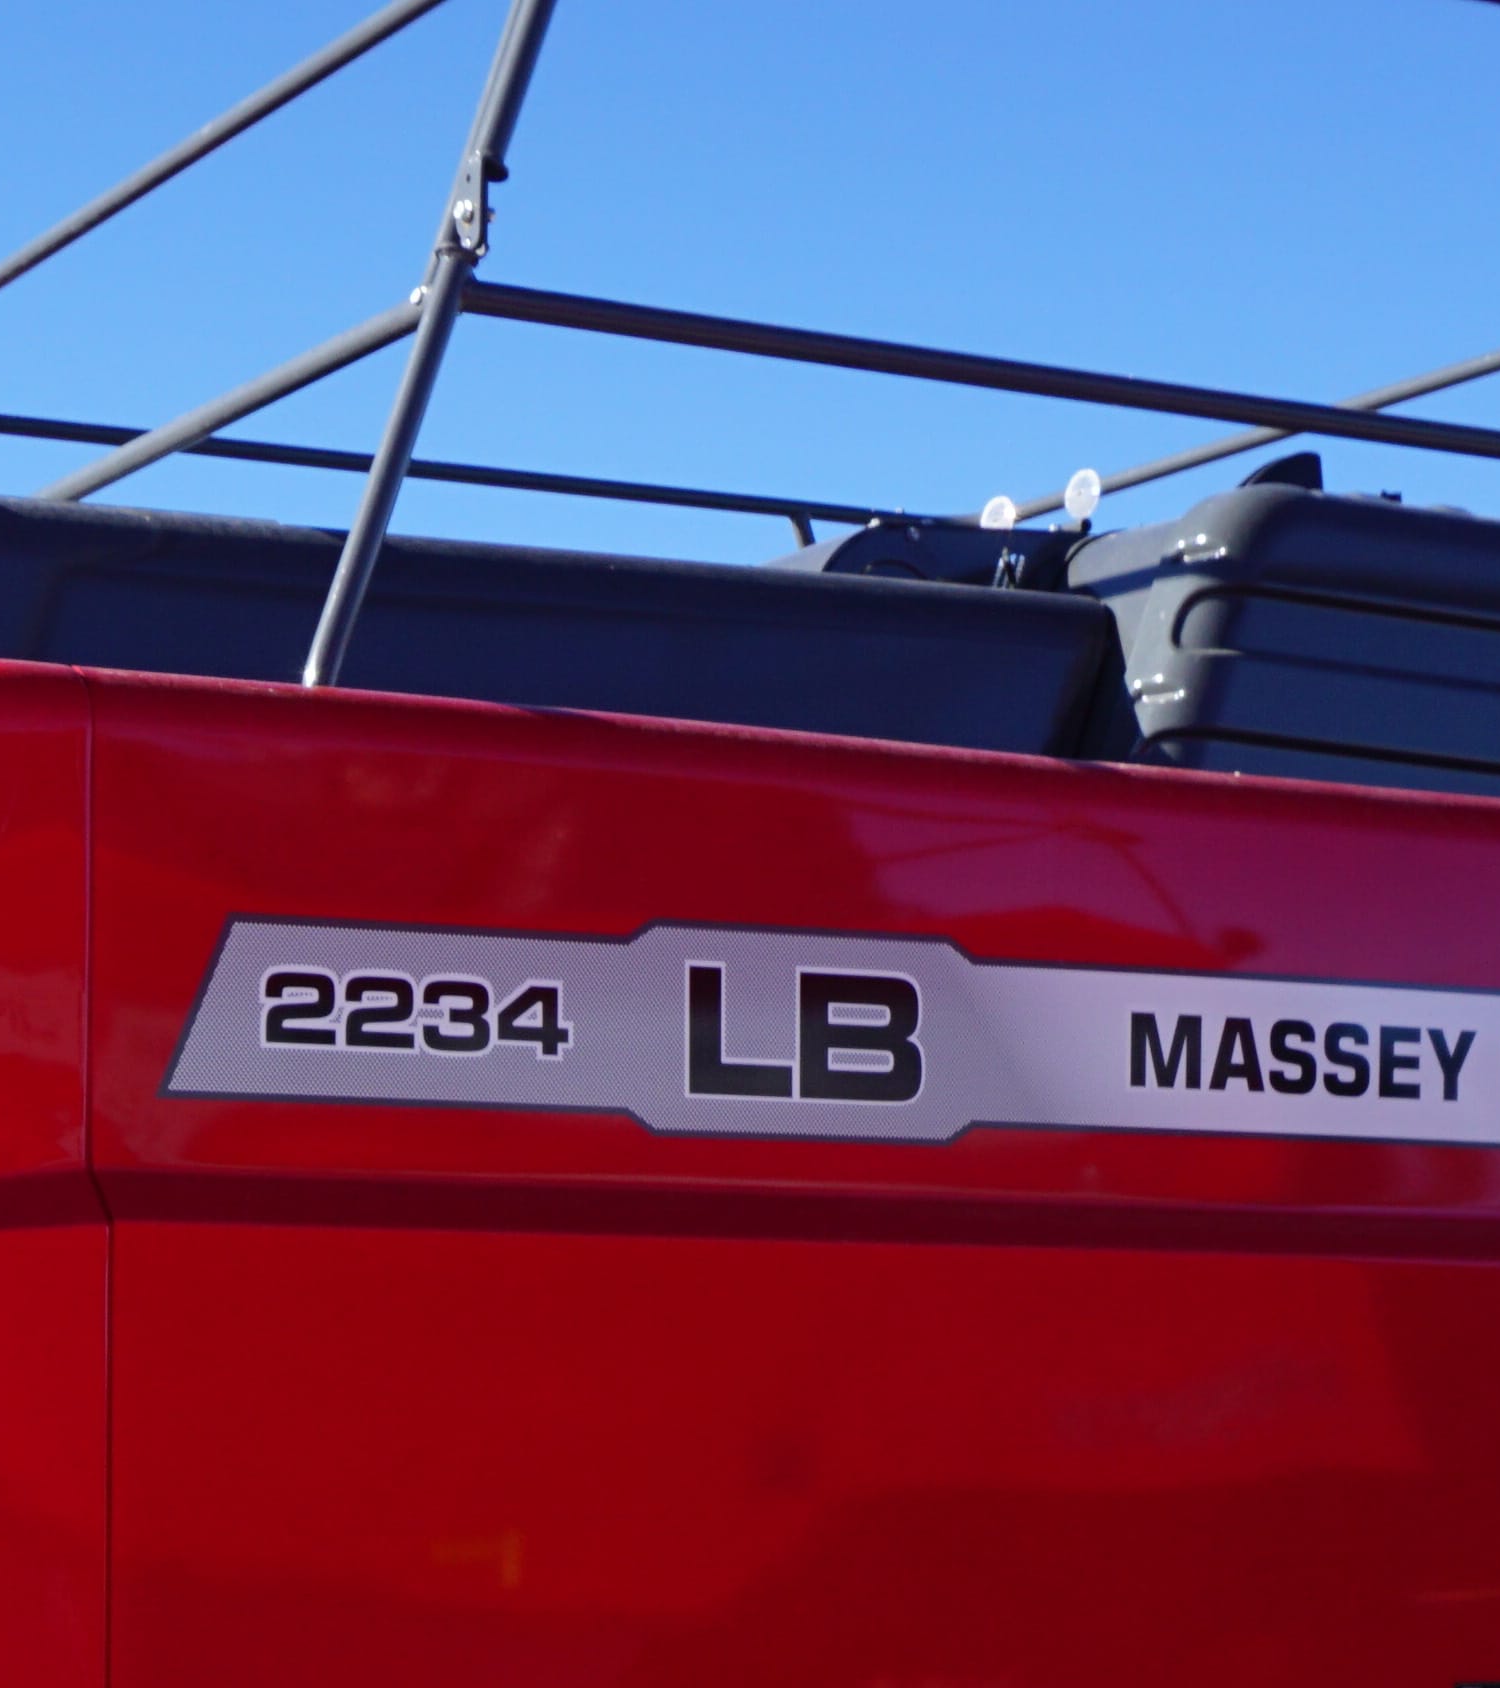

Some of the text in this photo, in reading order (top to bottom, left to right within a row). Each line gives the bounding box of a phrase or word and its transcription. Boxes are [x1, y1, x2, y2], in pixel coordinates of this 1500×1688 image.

[262, 966, 571, 1058] 2234
[686, 960, 925, 1102] LB
[1128, 1010, 1478, 1102] MASSEY
